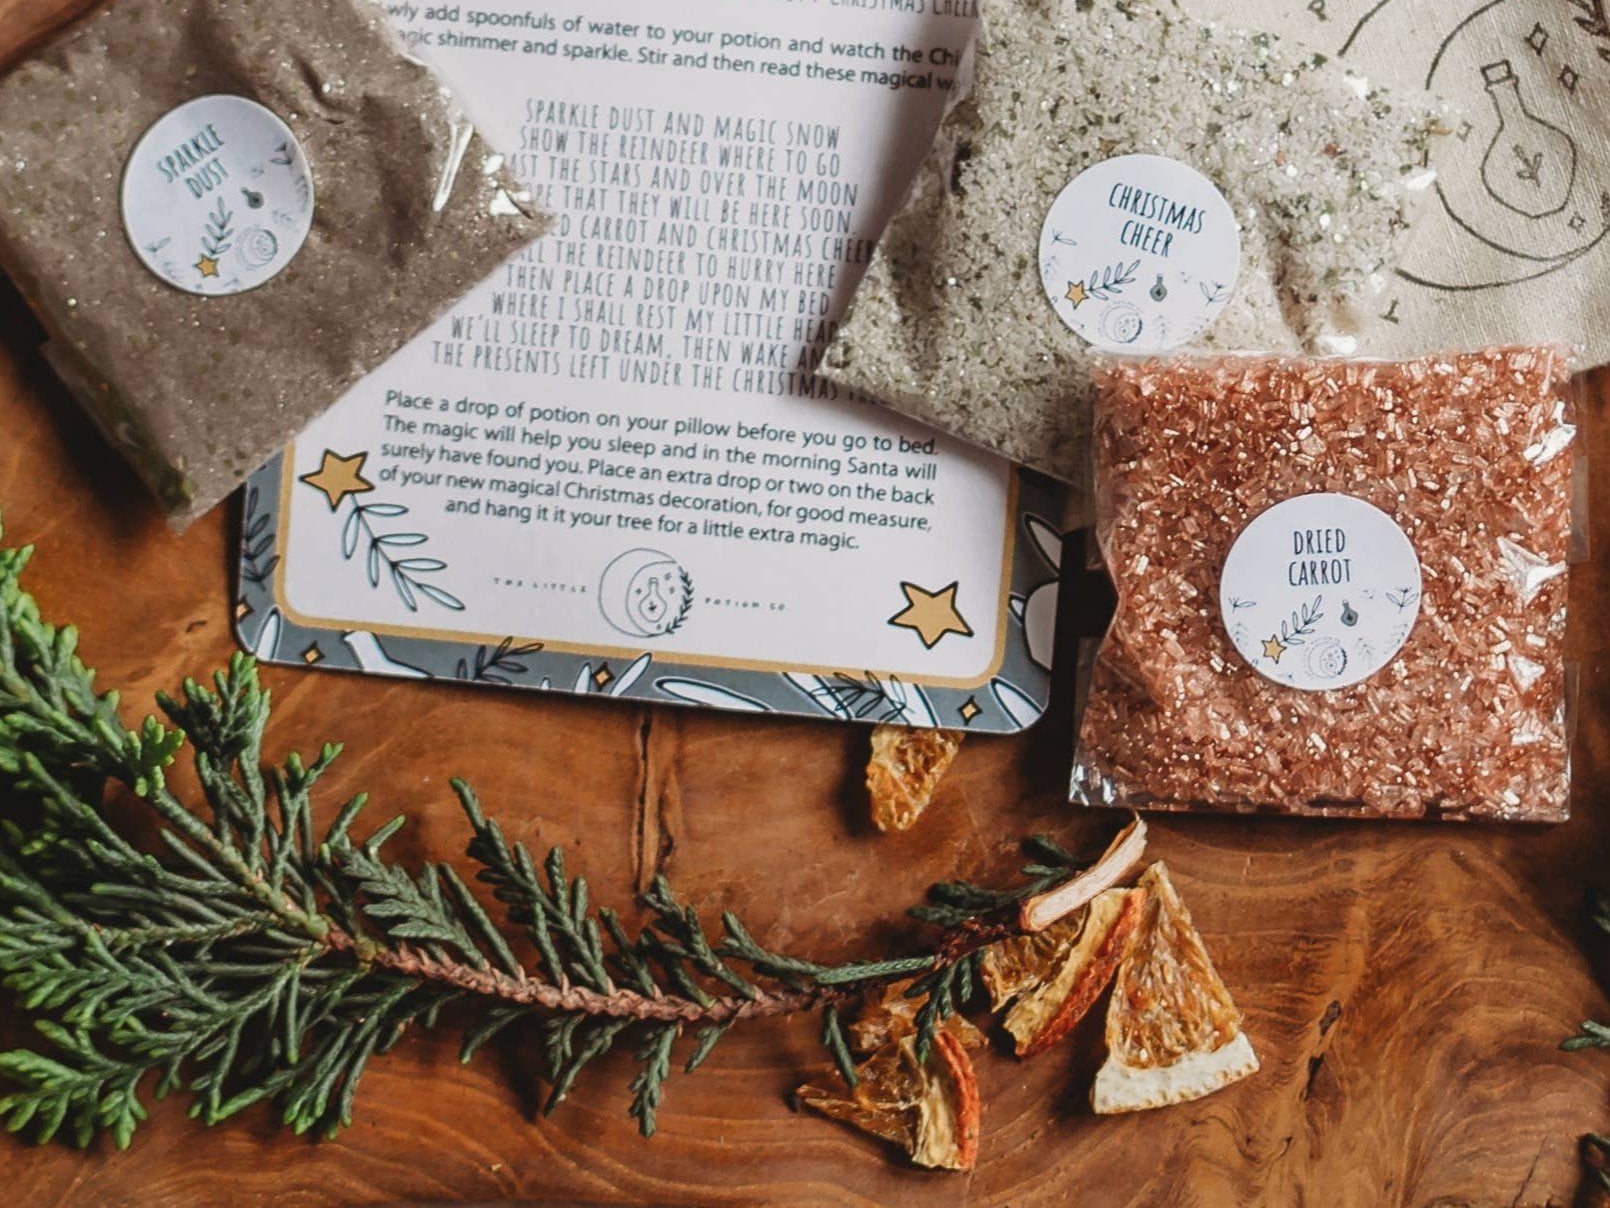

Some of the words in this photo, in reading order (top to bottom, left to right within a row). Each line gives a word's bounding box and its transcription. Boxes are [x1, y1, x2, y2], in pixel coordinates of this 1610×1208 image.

[527, 99, 599, 129] SPARKLE
[609, 106, 654, 132] DUST
[664, 111, 704, 137] AND
[714, 116, 776, 144] MAGIC
[787, 122, 839, 150] SNOW
[156, 124, 225, 183] SPARKLE
[184, 157, 229, 199] DUST
[520, 126, 568, 153] SHOW
[579, 131, 608, 157] THE
[619, 134, 708, 165] REINDEER
[719, 145, 774, 172] WHERE
[786, 149, 807, 175] TO
[817, 153, 840, 178] GO
[1109, 182, 1206, 234] CHRISTMAS
[1120, 220, 1174, 257] CHEER
[507, 264, 553, 291] THEN
[563, 270, 614, 297] PLACE
[623, 275, 632, 298] A
[643, 277, 689, 303] DROP
[699, 281, 749, 308] UPON
[760, 287, 788, 312] MY
[798, 290, 829, 316] BED
[383, 414, 417, 434] The
[422, 422, 479, 442] magic
[484, 426, 515, 442] will
[521, 427, 562, 450] help
[566, 436, 601, 452] you
[607, 436, 656, 459] sleep
[661, 442, 697, 459] and
[703, 444, 719, 461] in
[726, 446, 756, 464] the
[762, 453, 841, 476] morning
[847, 457, 898, 477] Santa
[905, 463, 937, 480] will
[385, 390, 434, 410] Place
[439, 399, 449, 412] a
[455, 397, 499, 419] drop
[504, 401, 526, 418] of
[529, 406, 590, 424] potion
[596, 413, 620, 427] on
[626, 416, 669, 432] your
[674, 417, 731, 437] pillow
[737, 421, 796, 443] before
[802, 432, 836, 448] you
[842, 435, 867, 452] go
[873, 436, 892, 451] to
[898, 435, 939, 455] bed.
[378, 464, 399, 482] of
[401, 471, 443, 487] your
[445, 475, 486, 490] new
[488, 478, 560, 498] magical
[563, 481, 655, 506] Christmas
[658, 490, 762, 518] decoration,
[767, 499, 793, 518] for
[796, 506, 845, 523] good
[848, 511, 931, 533] measure,
[381, 443, 436, 463] surely
[439, 444, 483, 465] have
[486, 449, 541, 470] found
[544, 459, 583, 475] you.
[587, 458, 636, 479] Place
[639, 467, 662, 481] an
[666, 470, 712, 486] extra
[716, 470, 761, 493] drop
[765, 478, 785, 492] or
[789, 479, 824, 496] two
[828, 484, 851, 498] on
[856, 483, 887, 501] the
[891, 485, 934, 506] back
[444, 498, 481, 515] and
[485, 499, 532, 523] hang
[536, 504, 549, 521] it
[553, 506, 566, 523] it
[570, 512, 612, 528] your
[617, 514, 653, 531] tree
[658, 514, 683, 533] for
[687, 522, 698, 535] a
[703, 519, 744, 539] little
[748, 527, 795, 544] extra
[800, 532, 859, 552] magic.
[1294, 528, 1346, 555] DRIED
[1288, 559, 1351, 586] CARROT
